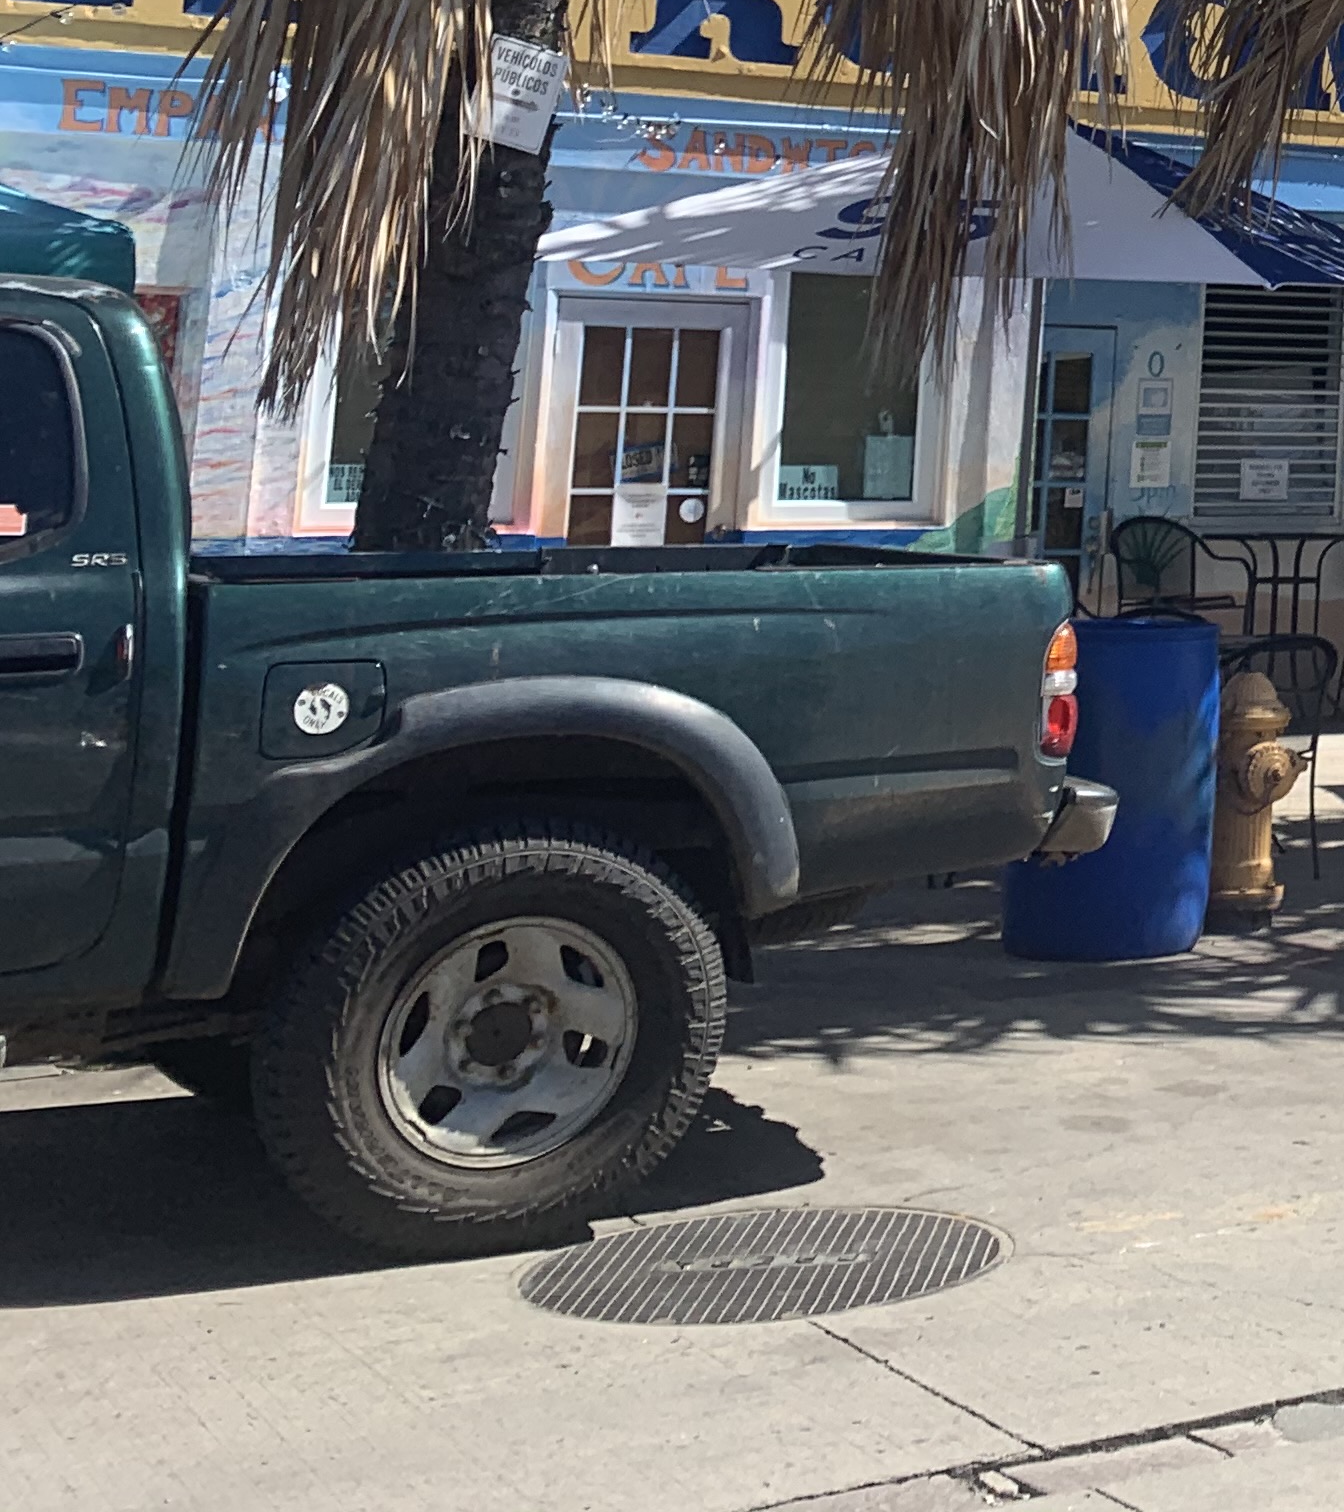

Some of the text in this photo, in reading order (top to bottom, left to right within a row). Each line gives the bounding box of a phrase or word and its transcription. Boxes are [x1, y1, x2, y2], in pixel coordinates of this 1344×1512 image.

[802, 467, 816, 484] No
[780, 483, 836, 500] Mascotas
[70, 552, 128, 568] SR5
